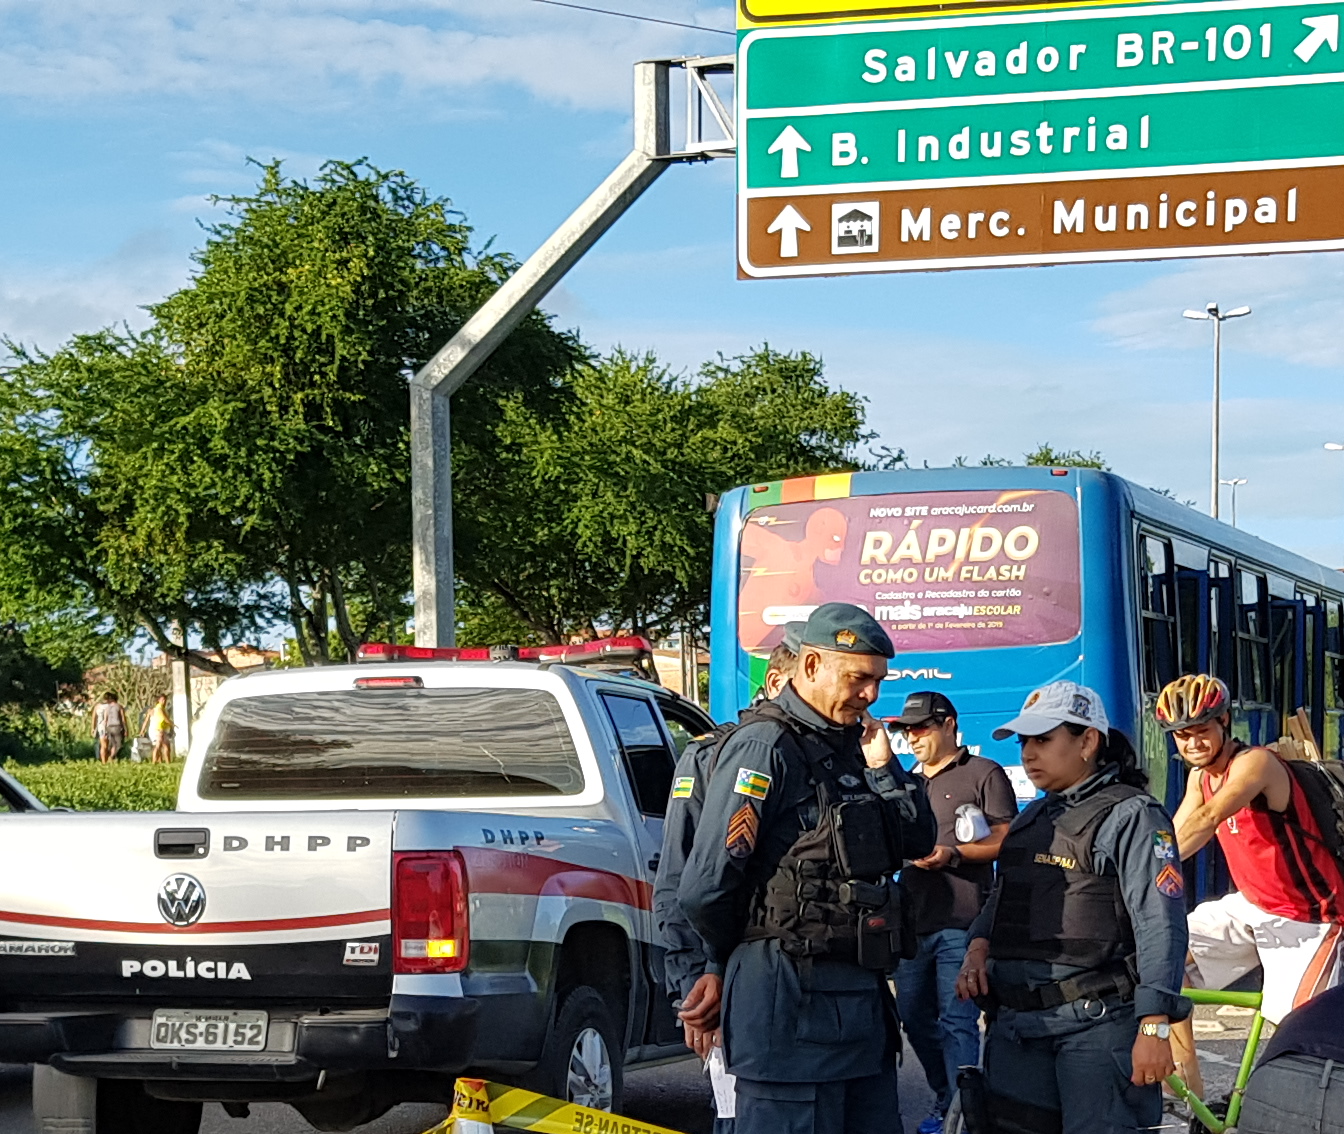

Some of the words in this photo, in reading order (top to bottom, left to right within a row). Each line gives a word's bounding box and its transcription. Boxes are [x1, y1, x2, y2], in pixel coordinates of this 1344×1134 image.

[862, 40, 1087, 84] Salvador
[1116, 22, 1272, 68] BR-101
[831, 132, 869, 167] B.
[897, 114, 1150, 163] Industrial
[900, 207, 1025, 243] Merc.
[1053, 187, 1297, 235] Municipal
[869, 507, 902, 518] NOVO
[904, 505, 928, 517] SITE
[930, 502, 1035, 517] aracajucard.com.br
[860, 519, 1040, 566] RÁPIDO
[858, 567, 919, 585] COMO
[924, 566, 955, 583] UM
[959, 564, 1027, 582] FLASH
[991, 588, 1022, 597] cartão
[874, 600, 922, 621] mais
[973, 605, 1022, 616] ESCOLAR
[223, 835, 371, 852] DHPP
[482, 828, 545, 846] DHPP
[121, 956, 252, 980] POLÍCIA
